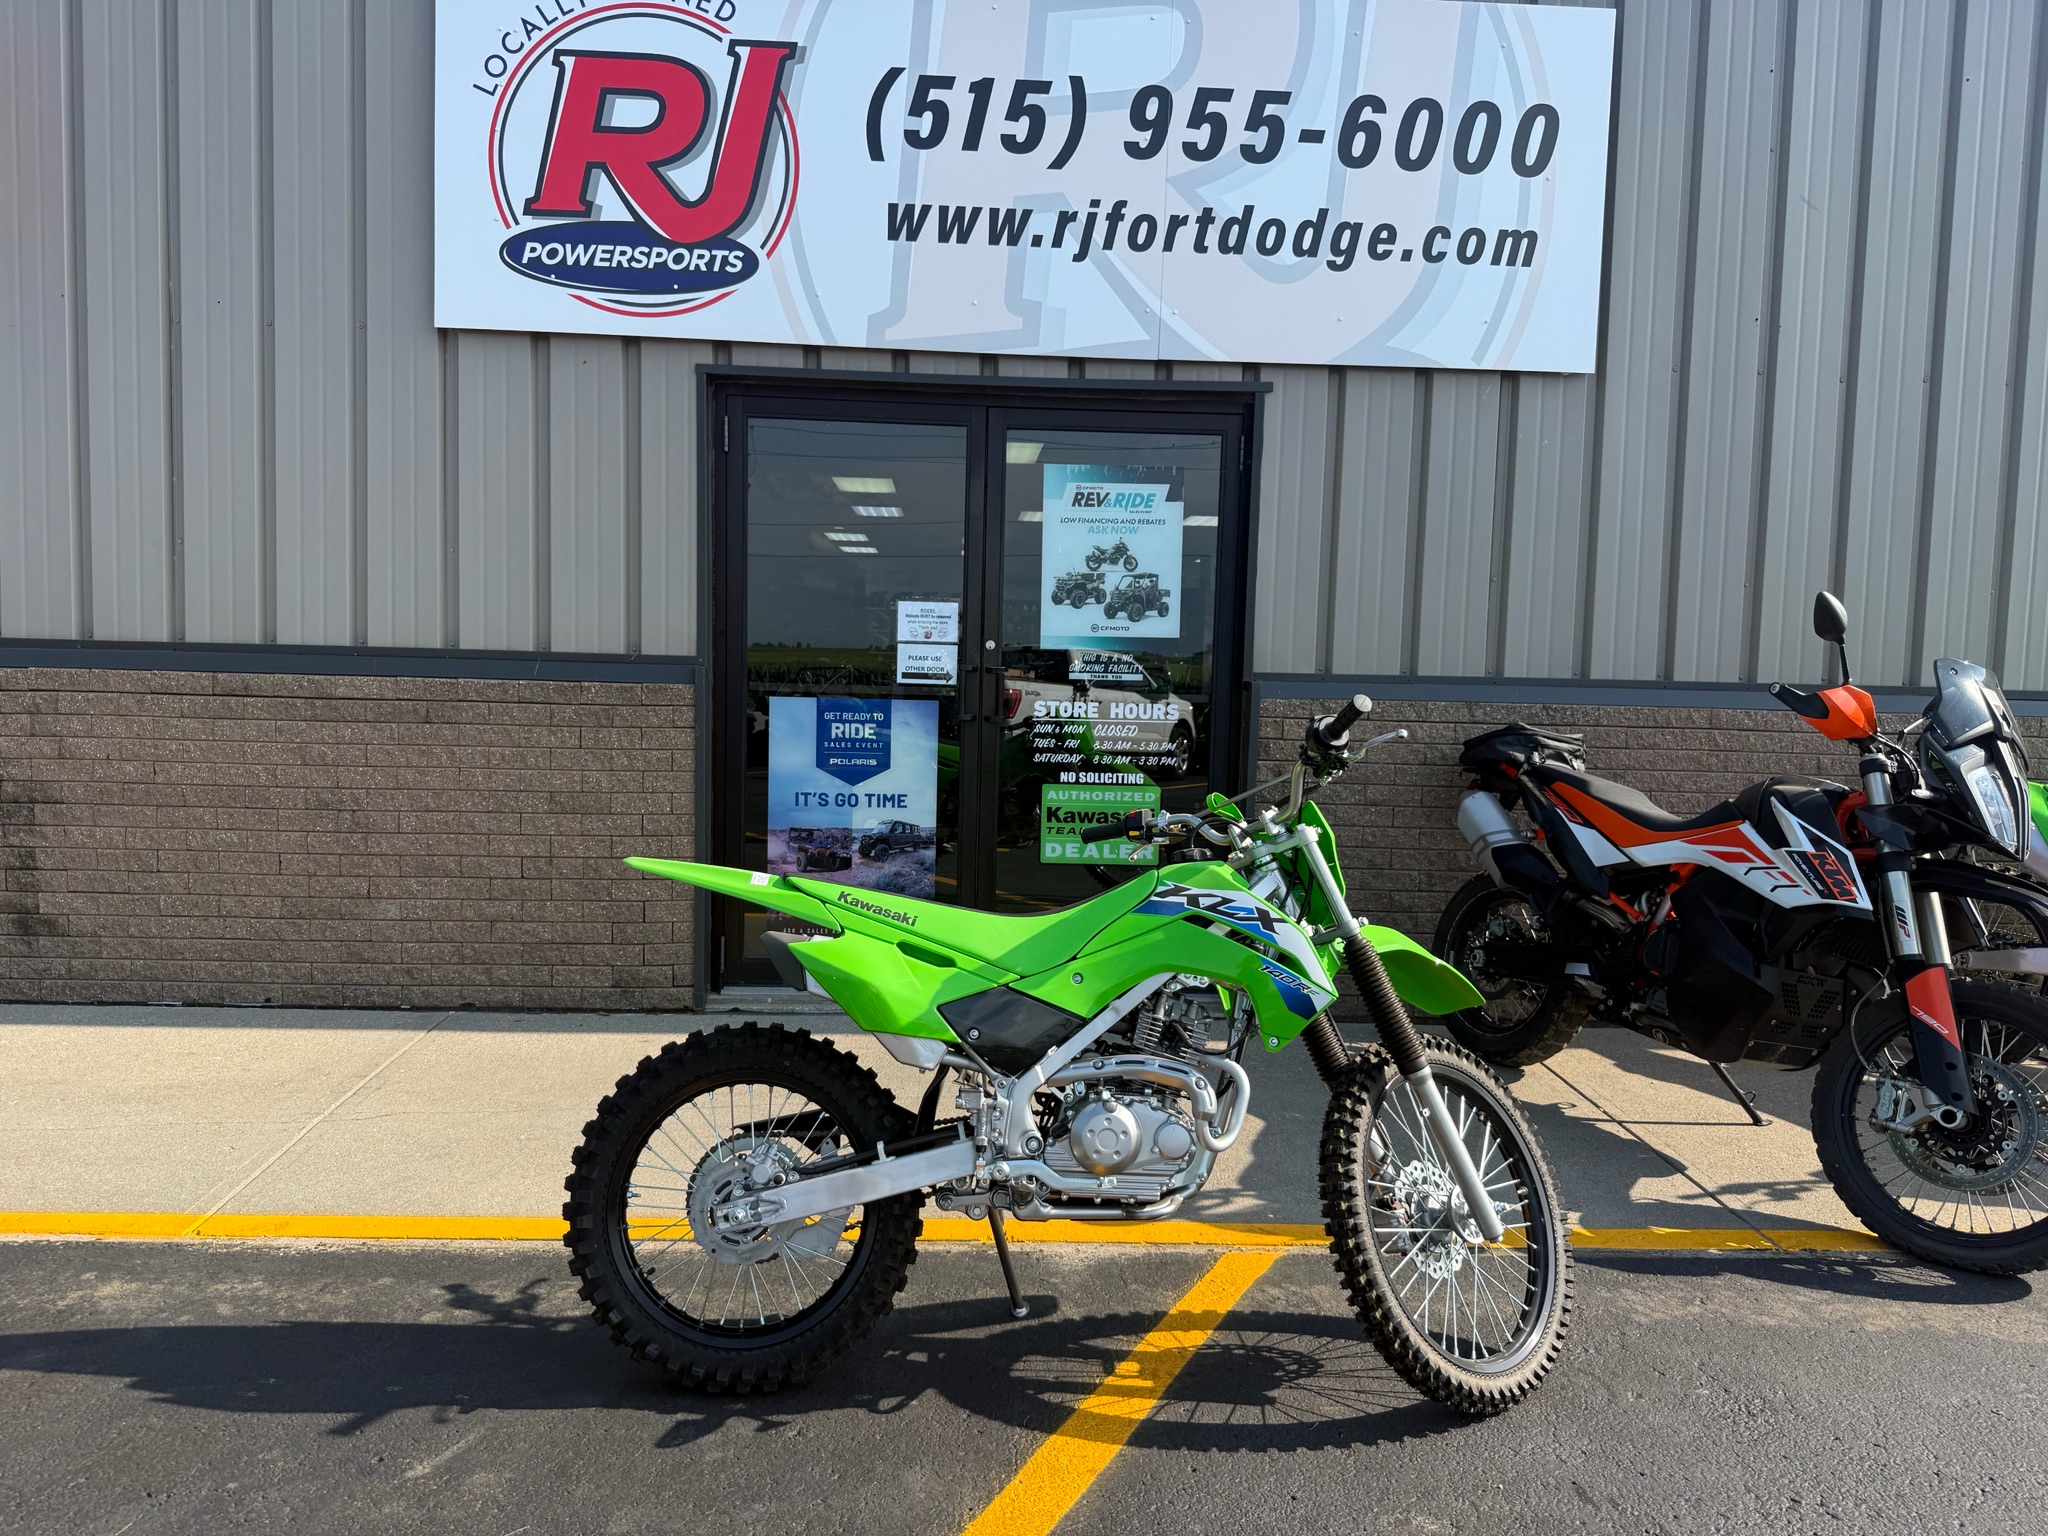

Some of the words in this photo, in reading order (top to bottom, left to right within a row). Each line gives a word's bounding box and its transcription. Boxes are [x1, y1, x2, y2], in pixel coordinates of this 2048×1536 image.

[865, 66, 1087, 170] (515)
[1122, 83, 1561, 178] 955-6000
[522, 38, 802, 244] RJ
[886, 198, 1539, 273] www.rjfortdodge.com
[521, 241, 744, 274] POWERSPORTS
[1078, 517, 1119, 525] FINANCING
[1137, 518, 1167, 526] REBATES
[1087, 525, 1109, 534] ASK
[1111, 525, 1140, 535] NOW
[1080, 652, 1097, 662] THIS
[1100, 653, 1109, 662] IS
[1112, 653, 1119, 662] A
[1121, 653, 1134, 662] NO
[1068, 663, 1105, 673] SMOKING
[1107, 664, 1144, 673] FACILITY
[824, 711, 841, 720] GET
[842, 712, 871, 721] READY
[872, 713, 884, 721] TO
[1033, 700, 1099, 718] STORE
[1109, 702, 1180, 720] HOURS
[831, 722, 877, 740] RIDE
[1034, 723, 1056, 734] SUN
[1061, 724, 1087, 734] MON
[1093, 724, 1139, 737] CLOSED
[1033, 738, 1056, 748] TUES
[1063, 739, 1081, 749] FRI
[1113, 740, 1132, 750] AM
[1160, 742, 1177, 751] PM
[829, 758, 878, 766] POLARIS
[1033, 753, 1083, 764] SATURDAY
[1113, 754, 1132, 765] AM
[1159, 756, 1177, 766] PM
[1060, 771, 1077, 783] NO
[1078, 771, 1144, 785] SOLICITING
[794, 791, 830, 807] IT'S
[834, 792, 859, 808] GO
[864, 793, 908, 809] TIME
[1046, 790, 1156, 802] AUTHORIZED
[1046, 826, 1082, 835] TEA
[1045, 842, 1155, 860] DEALER
[1805, 851, 1858, 901] KTM
[837, 890, 918, 927] Kawasaki
[1151, 881, 1293, 936] KLX
